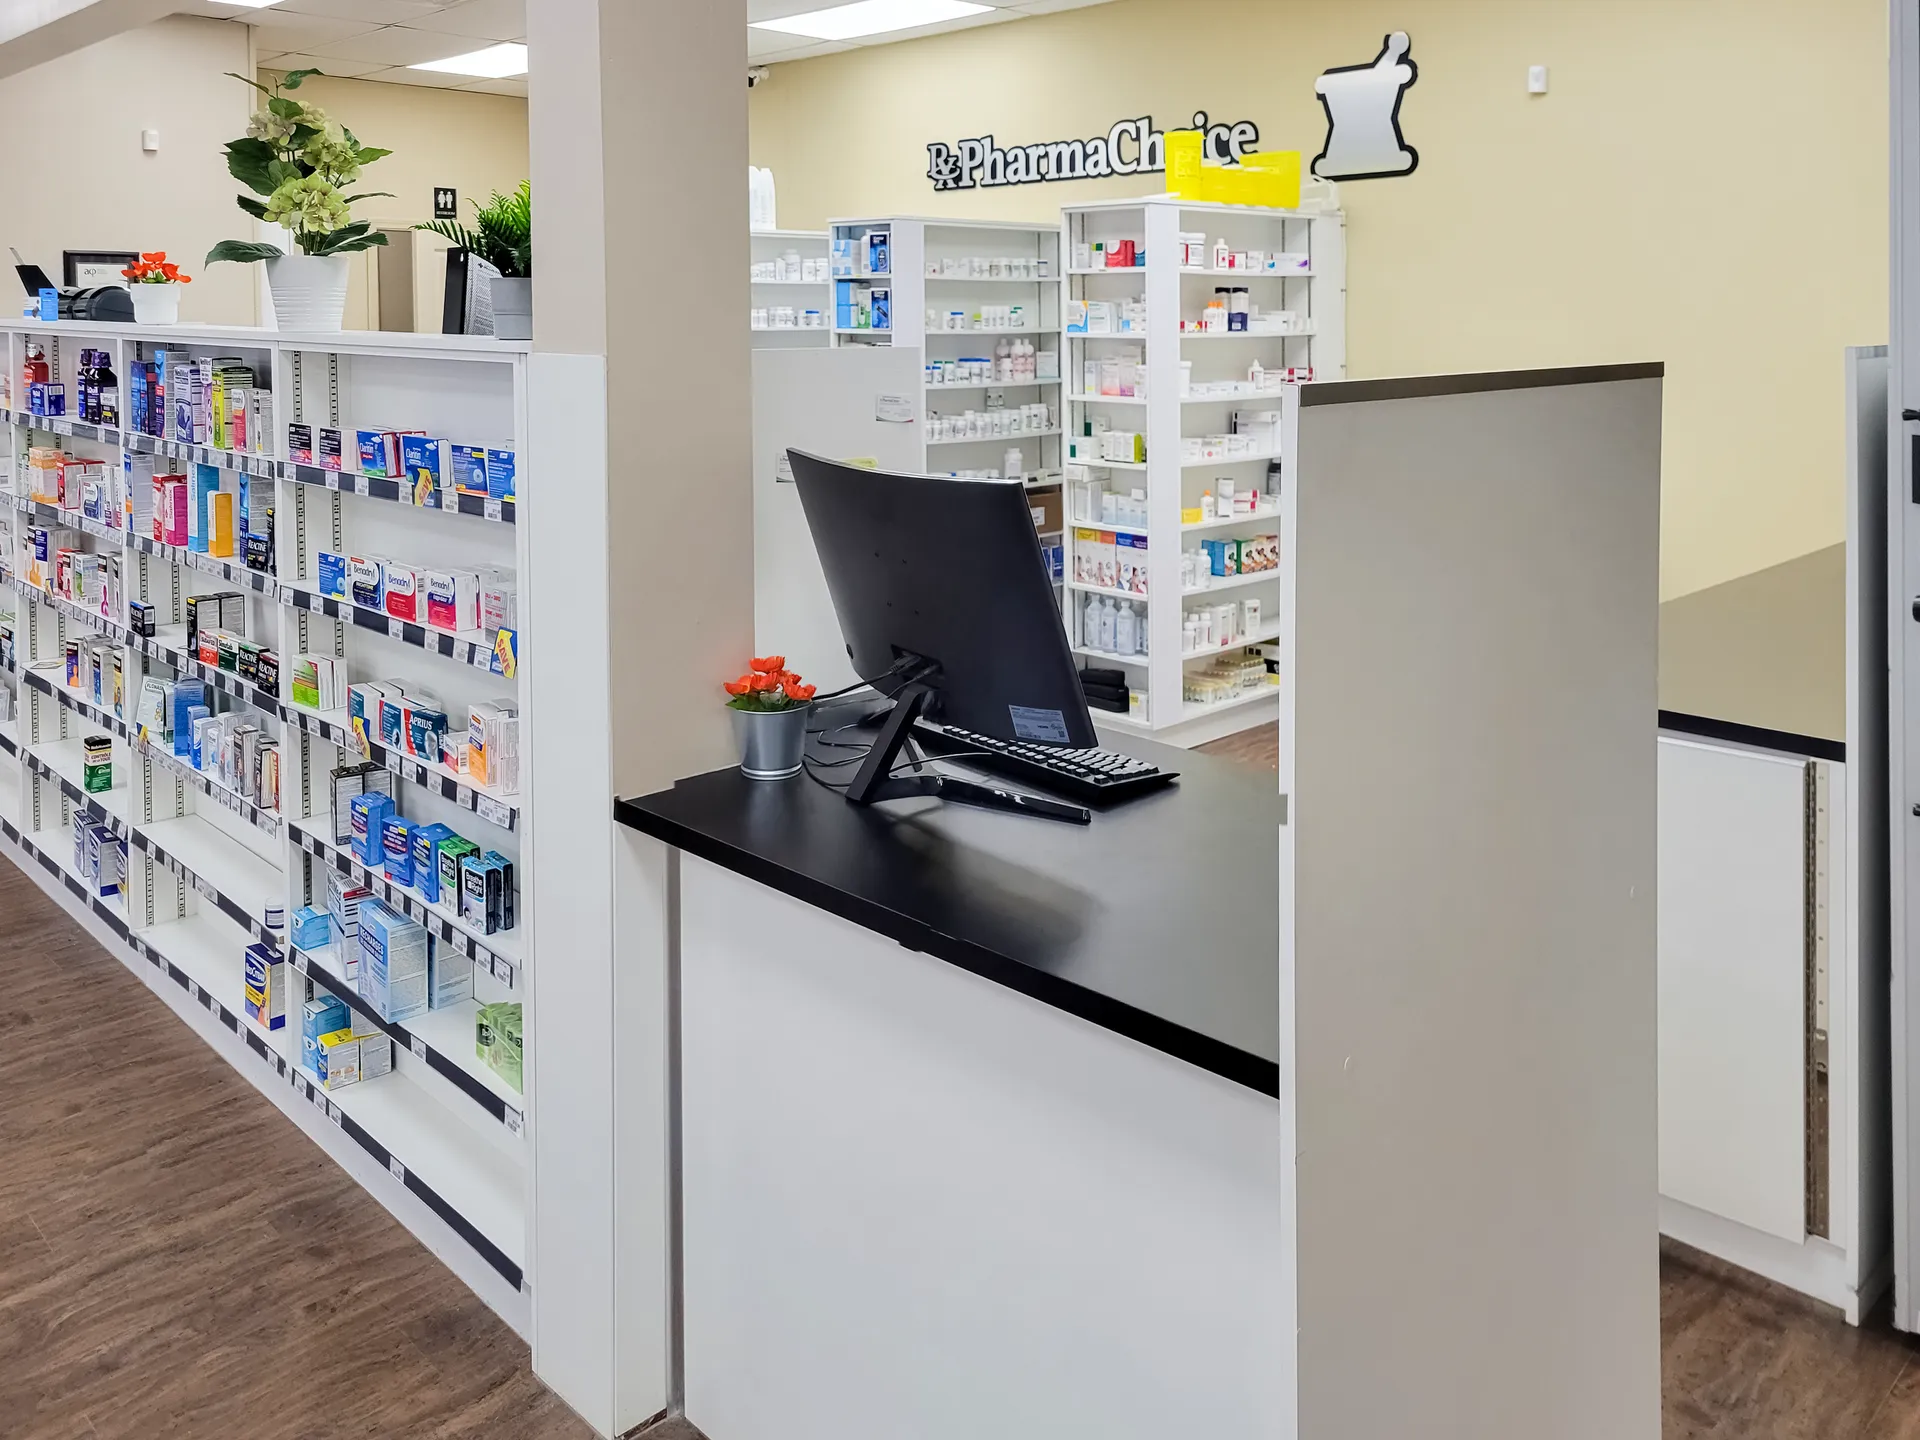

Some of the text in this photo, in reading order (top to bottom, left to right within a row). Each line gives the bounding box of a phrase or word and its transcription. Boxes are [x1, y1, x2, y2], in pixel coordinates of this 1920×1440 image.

[958, 110, 1259, 189] PharmaChice
[359, 442, 374, 454] Claritin
[405, 448, 422, 460] Claritin
[418, 475, 432, 505] SAVE
[353, 563, 376, 580] Benadryl
[388, 573, 411, 589] Benadryl
[430, 577, 450, 591] Benadryl
[497, 638, 512, 674] SAVE
[259, 660, 278, 678] REACTINE
